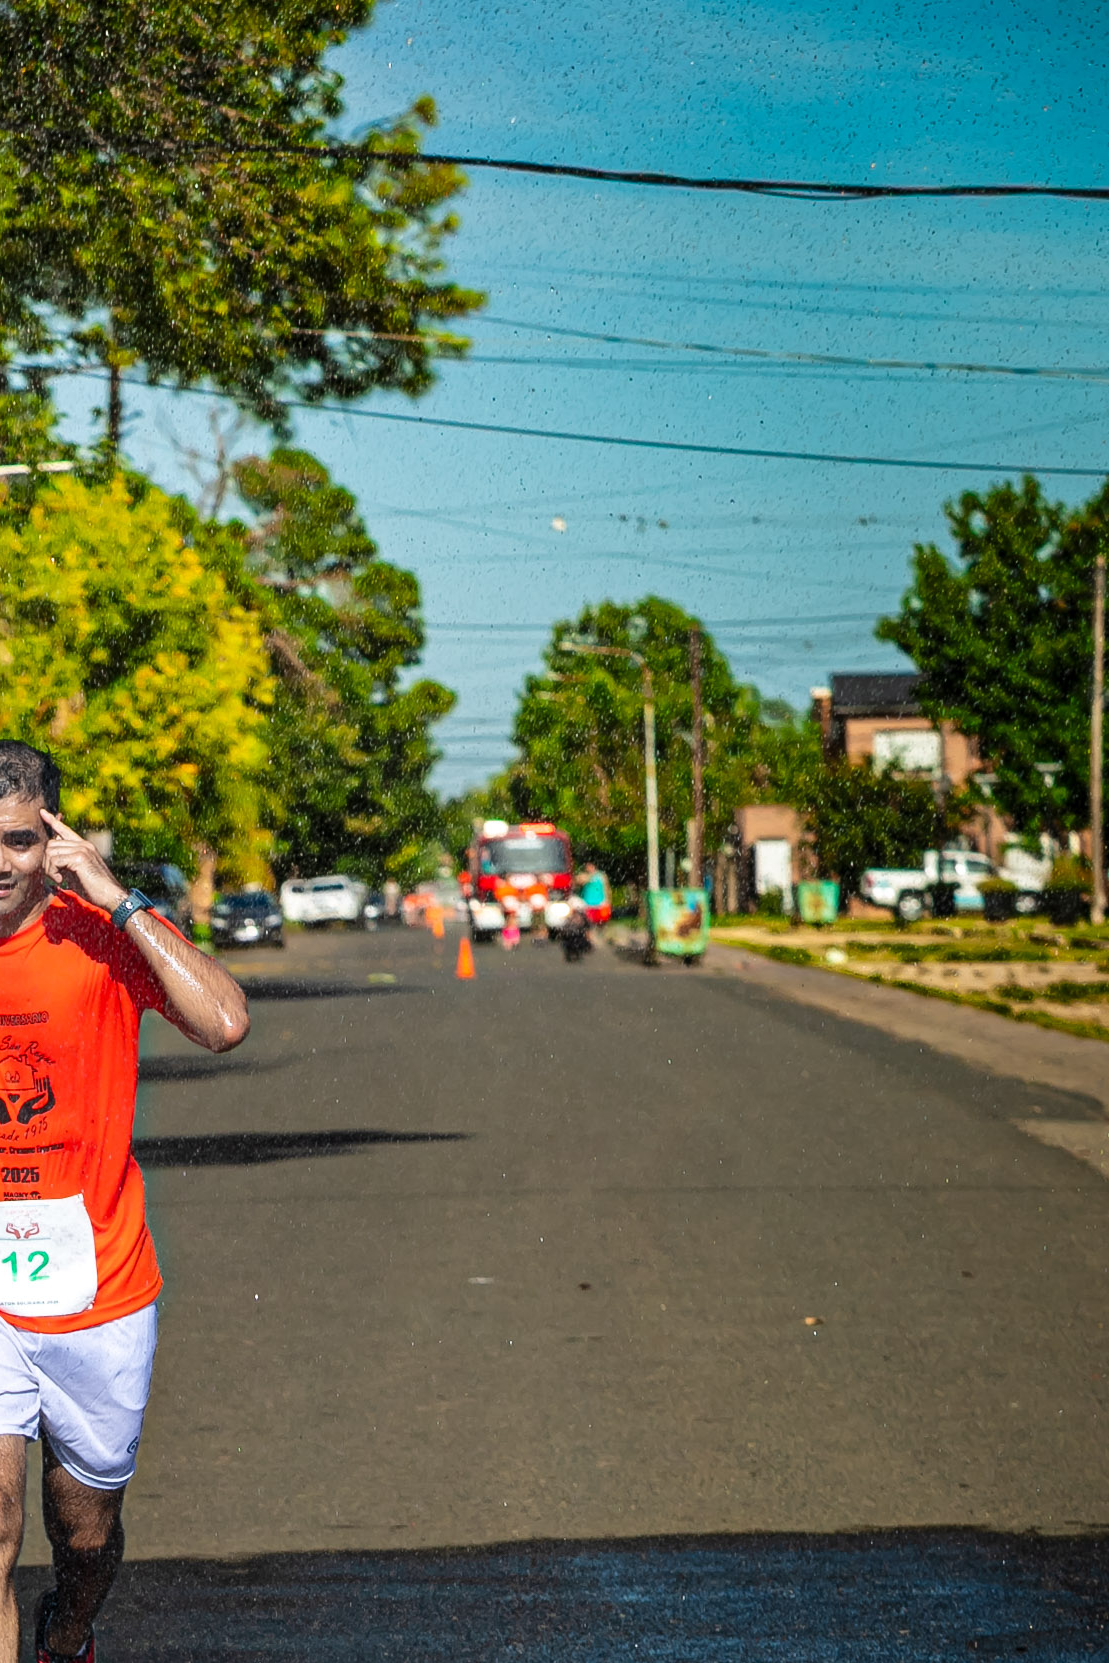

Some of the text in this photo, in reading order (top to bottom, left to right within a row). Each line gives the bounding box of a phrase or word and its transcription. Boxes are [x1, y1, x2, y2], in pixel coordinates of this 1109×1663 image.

[0, 1035, 21, 1050] San
[24, 1116, 48, 1139] 1975
[1, 1166, 40, 1183] 2025
[1, 1250, 50, 1282] 12
